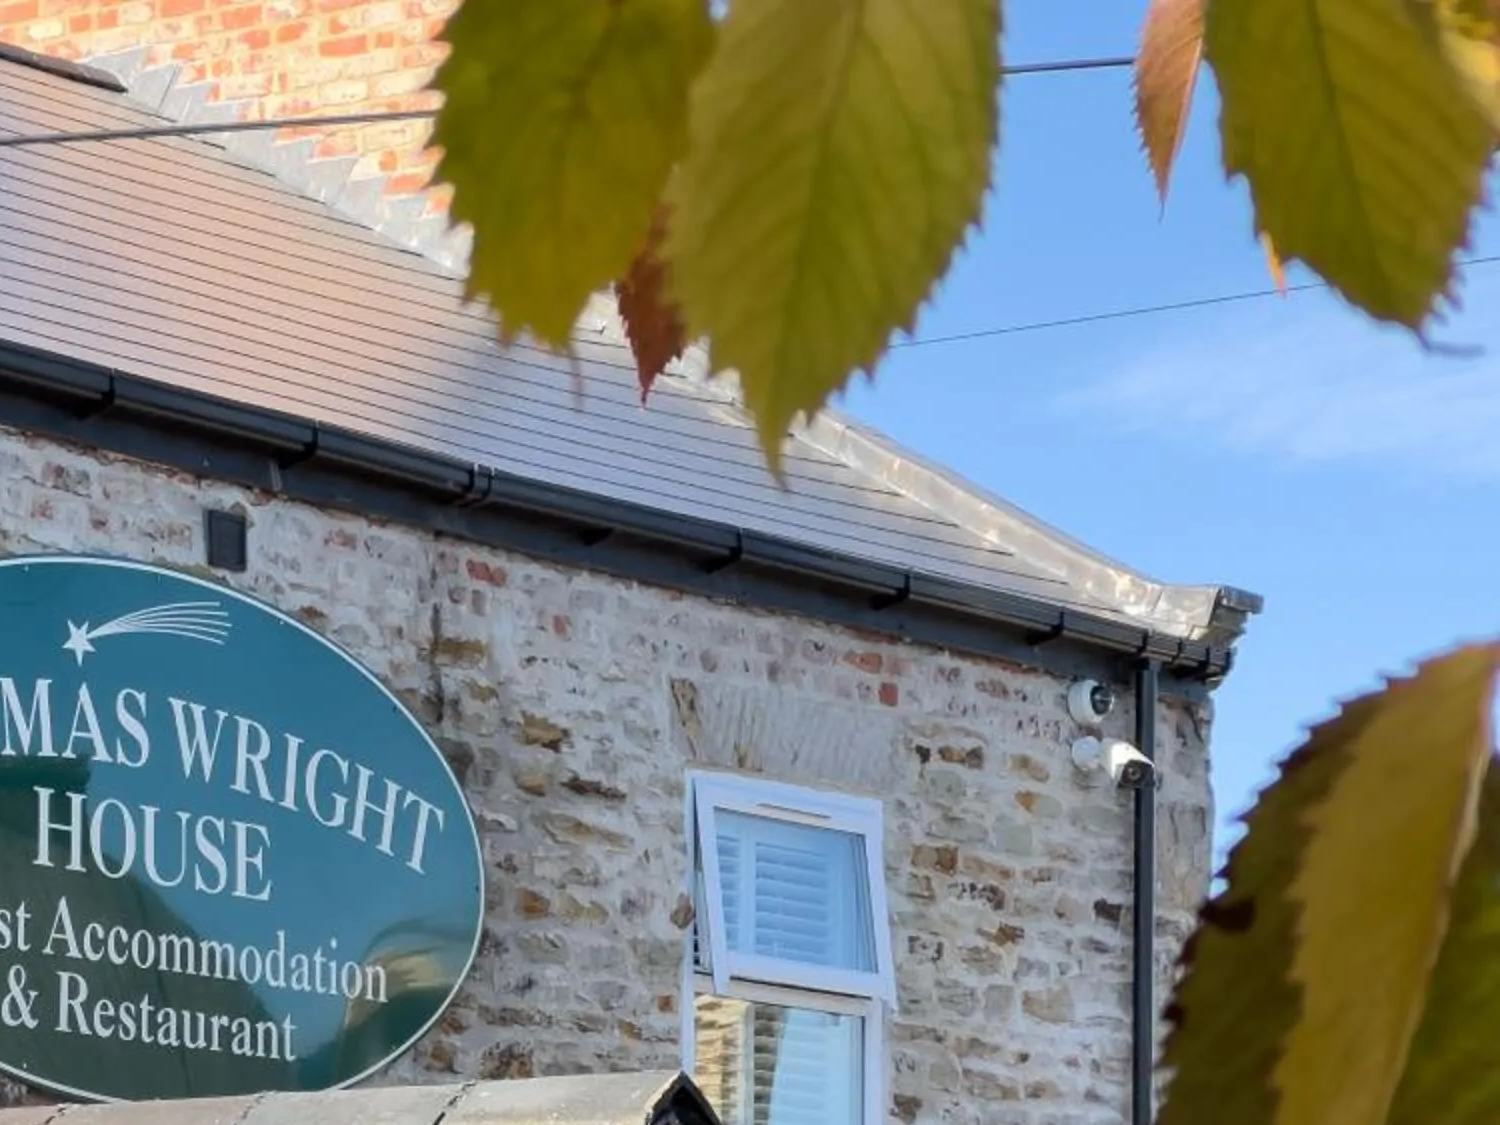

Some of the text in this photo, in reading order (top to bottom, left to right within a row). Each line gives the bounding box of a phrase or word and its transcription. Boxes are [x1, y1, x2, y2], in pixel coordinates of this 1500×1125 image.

[169, 697, 445, 875] WRIGHT
[32, 786, 272, 901] HOUSE
[42, 896, 388, 1003] Accommodation
[1, 964, 297, 1061] & Restaurant
